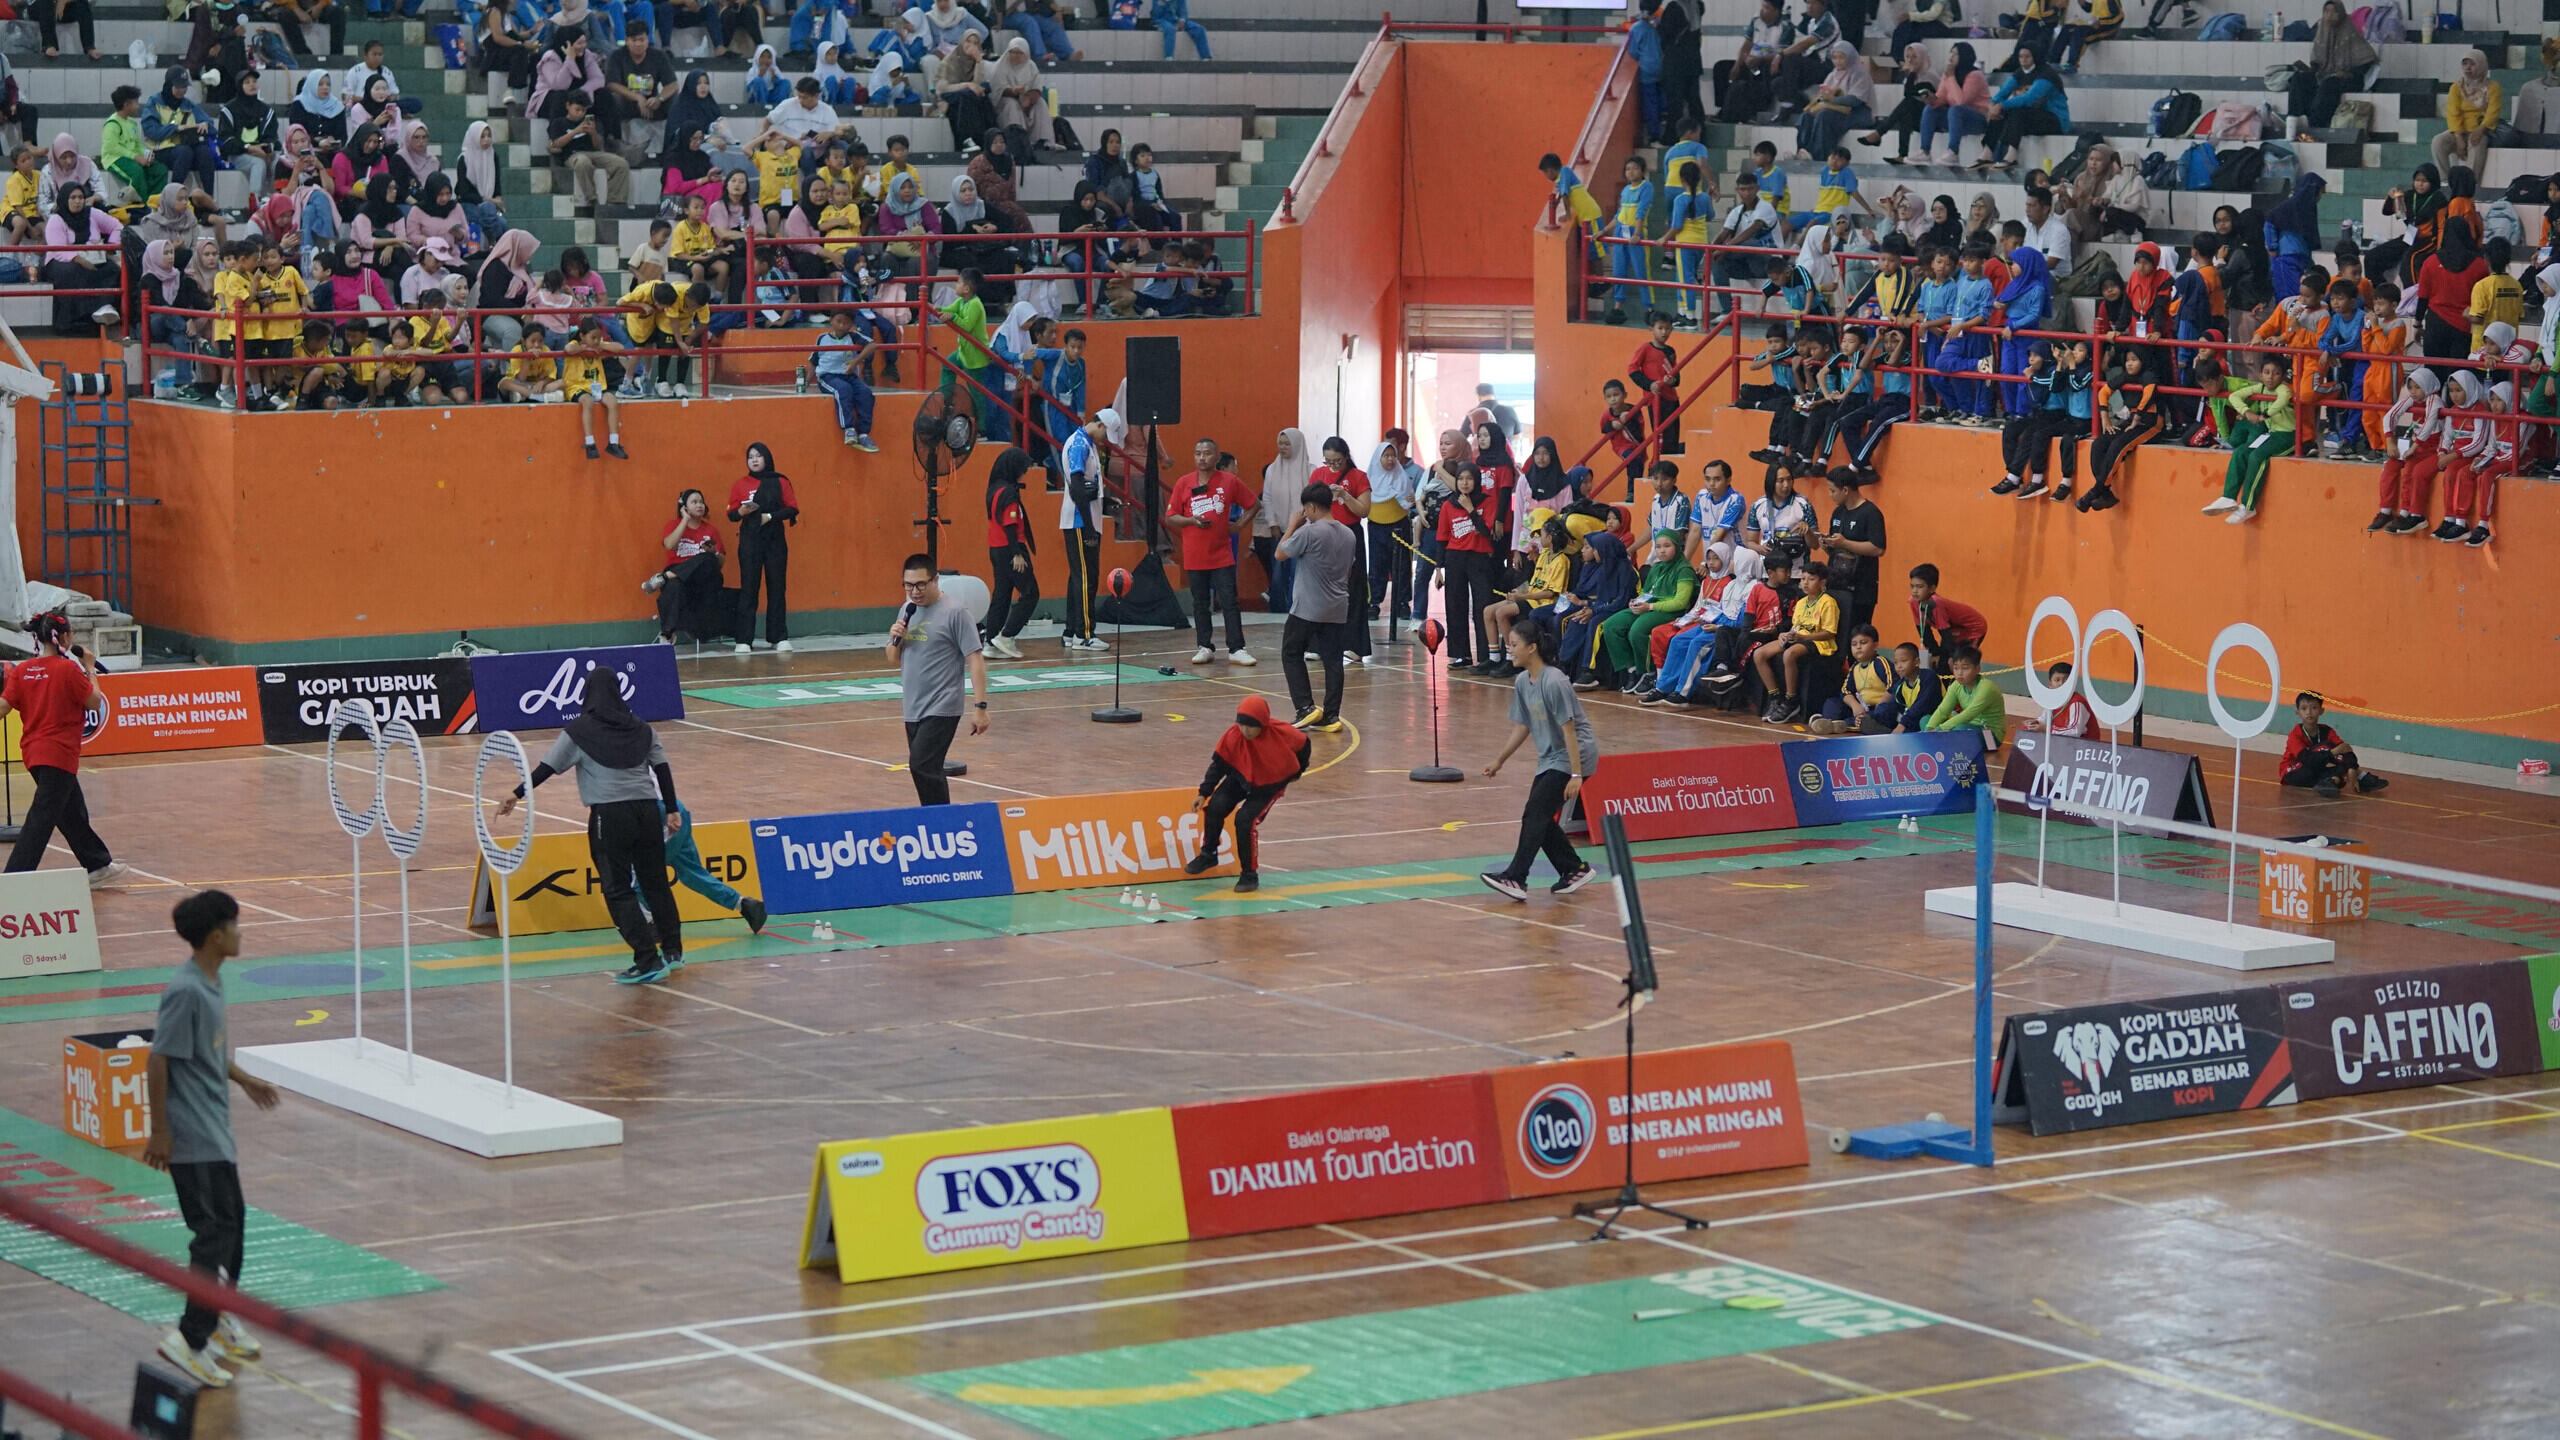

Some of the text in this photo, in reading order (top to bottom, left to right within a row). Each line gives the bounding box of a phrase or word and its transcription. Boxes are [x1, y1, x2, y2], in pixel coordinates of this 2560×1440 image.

[120, 690, 241, 709] BENERAN MURNI
[298, 674, 438, 696] KOPI TUBRUK
[117, 711, 188, 727] BENERAN
[190, 708, 248, 724] RINGAN
[1653, 774, 1718, 789] Bakti Olahraga
[1827, 752, 1938, 789] KENKO
[1604, 784, 1775, 816] DJARUM foundation
[781, 824, 978, 880] hydroplus
[902, 869, 984, 886] ISOTONIC DRINK
[2265, 862, 2307, 893] Milk
[2319, 864, 2362, 892] Milk
[2272, 890, 2308, 919] Life
[2325, 890, 2364, 918] Life
[2375, 981, 2440, 1006] DELIZIO
[2120, 1004, 2240, 1034] KOPI TUBRUK
[2124, 1023, 2246, 1064] GADJAH
[2331, 1002, 2498, 1085] CAFFINO
[67, 1064, 98, 1106] Milk
[2130, 1062, 2250, 1093] BENAR BENAR
[1608, 1080, 1773, 1117] BENERAN MURNI
[2173, 1086, 2215, 1106] KOPI
[73, 1099, 100, 1139] Life
[1533, 1114, 1583, 1151] Cleo
[1607, 1106, 1784, 1146] BENERAN RINGAN
[1287, 1125, 1390, 1149] Bakti Olahraga
[1209, 1136, 1475, 1196] DJARUM foundation
[936, 1157, 1081, 1215] FOX'S
[925, 1205, 1103, 1254] Gummy Candy
